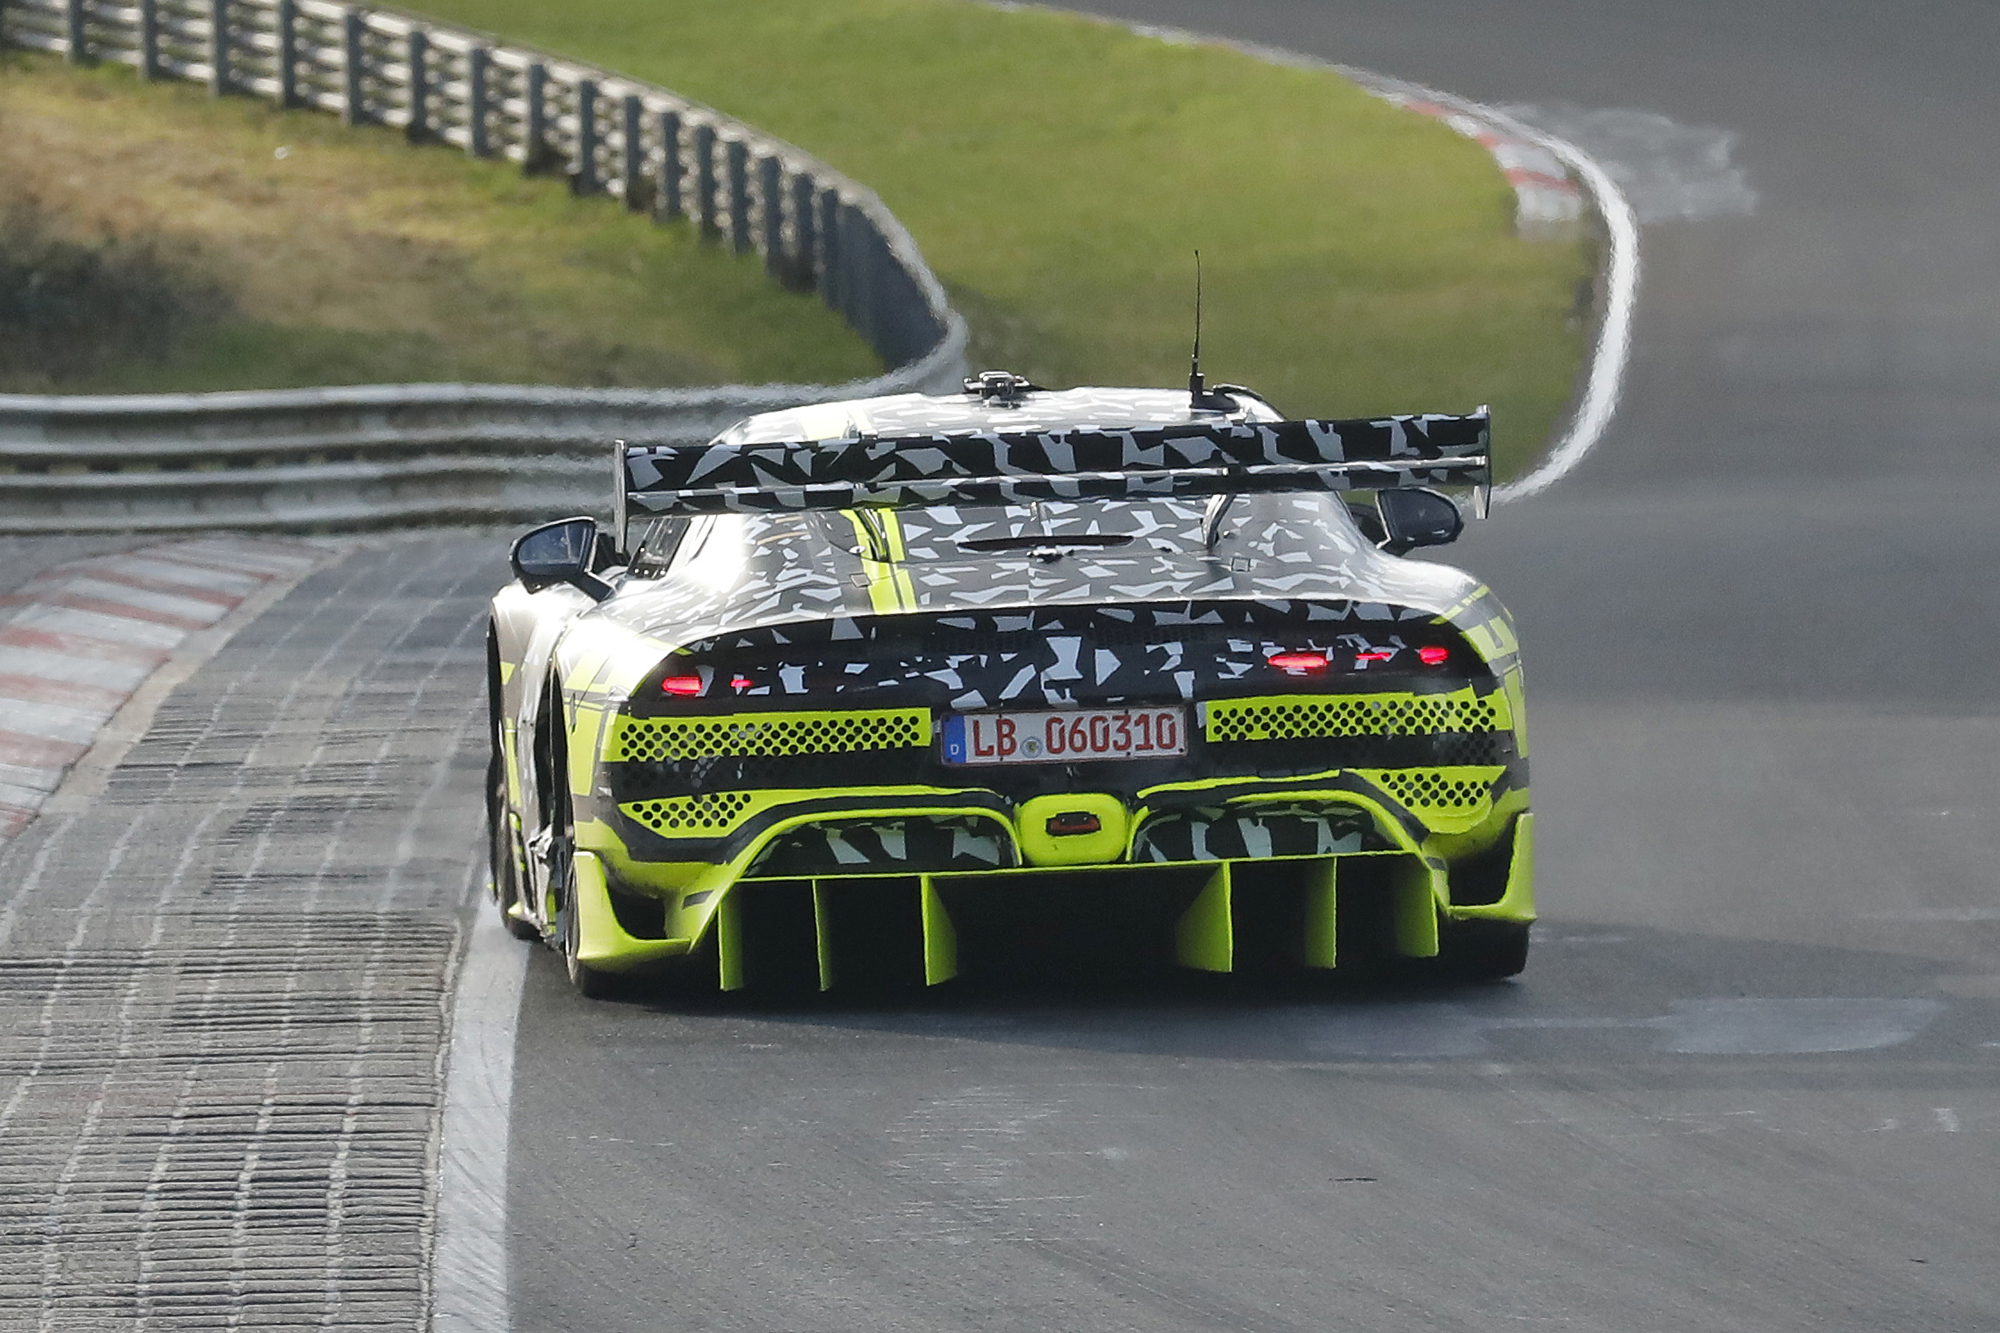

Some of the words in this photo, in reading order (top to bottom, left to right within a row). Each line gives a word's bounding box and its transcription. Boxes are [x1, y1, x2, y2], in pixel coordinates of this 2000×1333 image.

[972, 717, 1018, 757] LB
[1045, 712, 1177, 755] 060310
[950, 743, 960, 756] D
